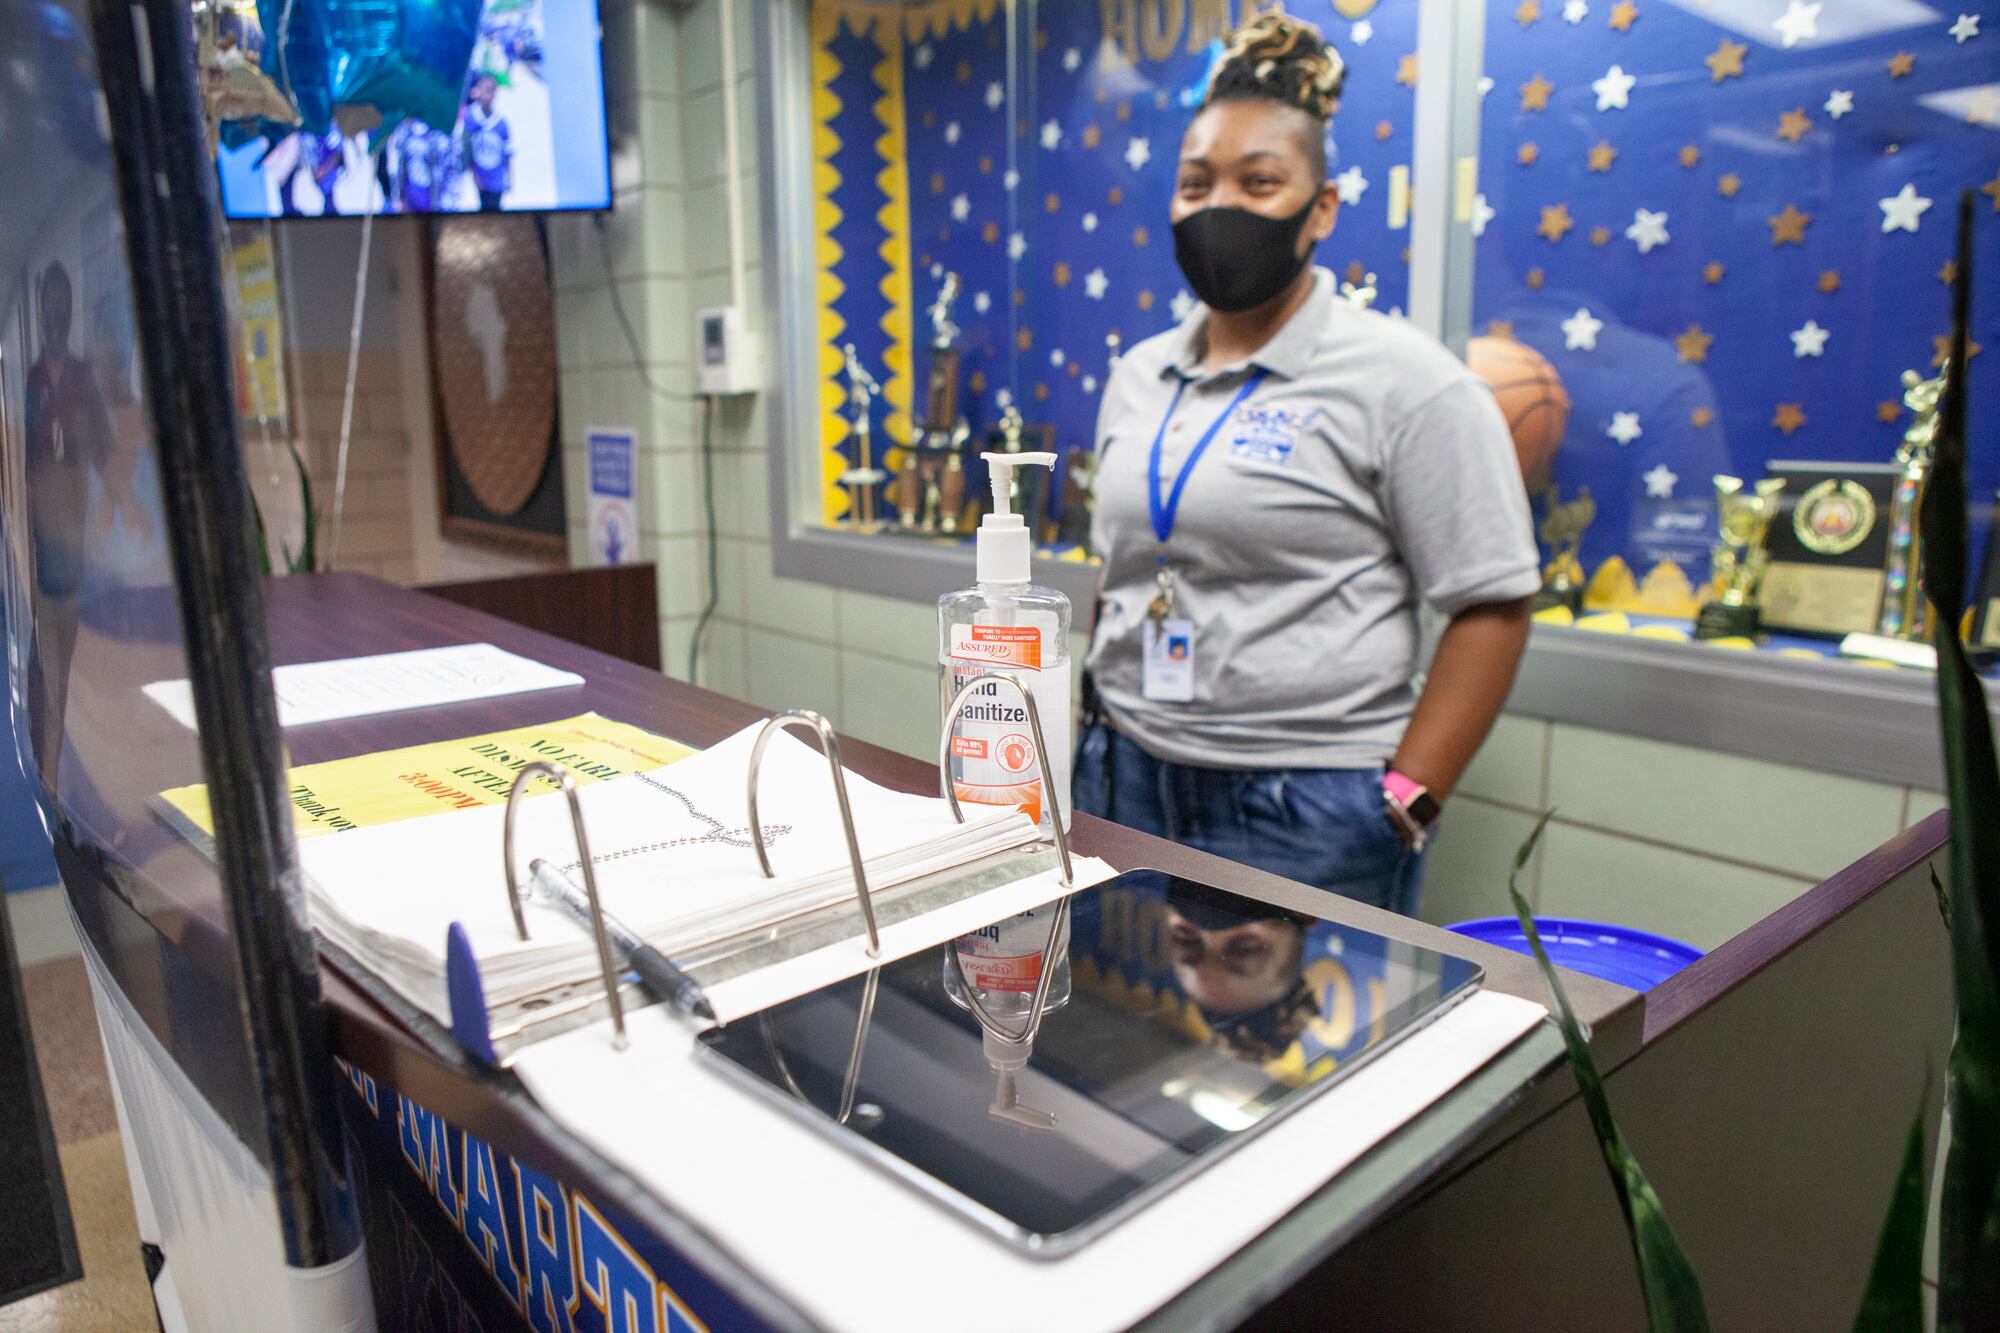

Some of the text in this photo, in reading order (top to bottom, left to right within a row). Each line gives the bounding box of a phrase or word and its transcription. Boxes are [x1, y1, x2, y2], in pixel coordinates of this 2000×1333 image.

[957, 641, 1011, 658] ASSURED
[956, 739, 969, 747] Kills
[290, 785, 340, 818] Thank
[399, 772, 485, 809] 3:00PM
